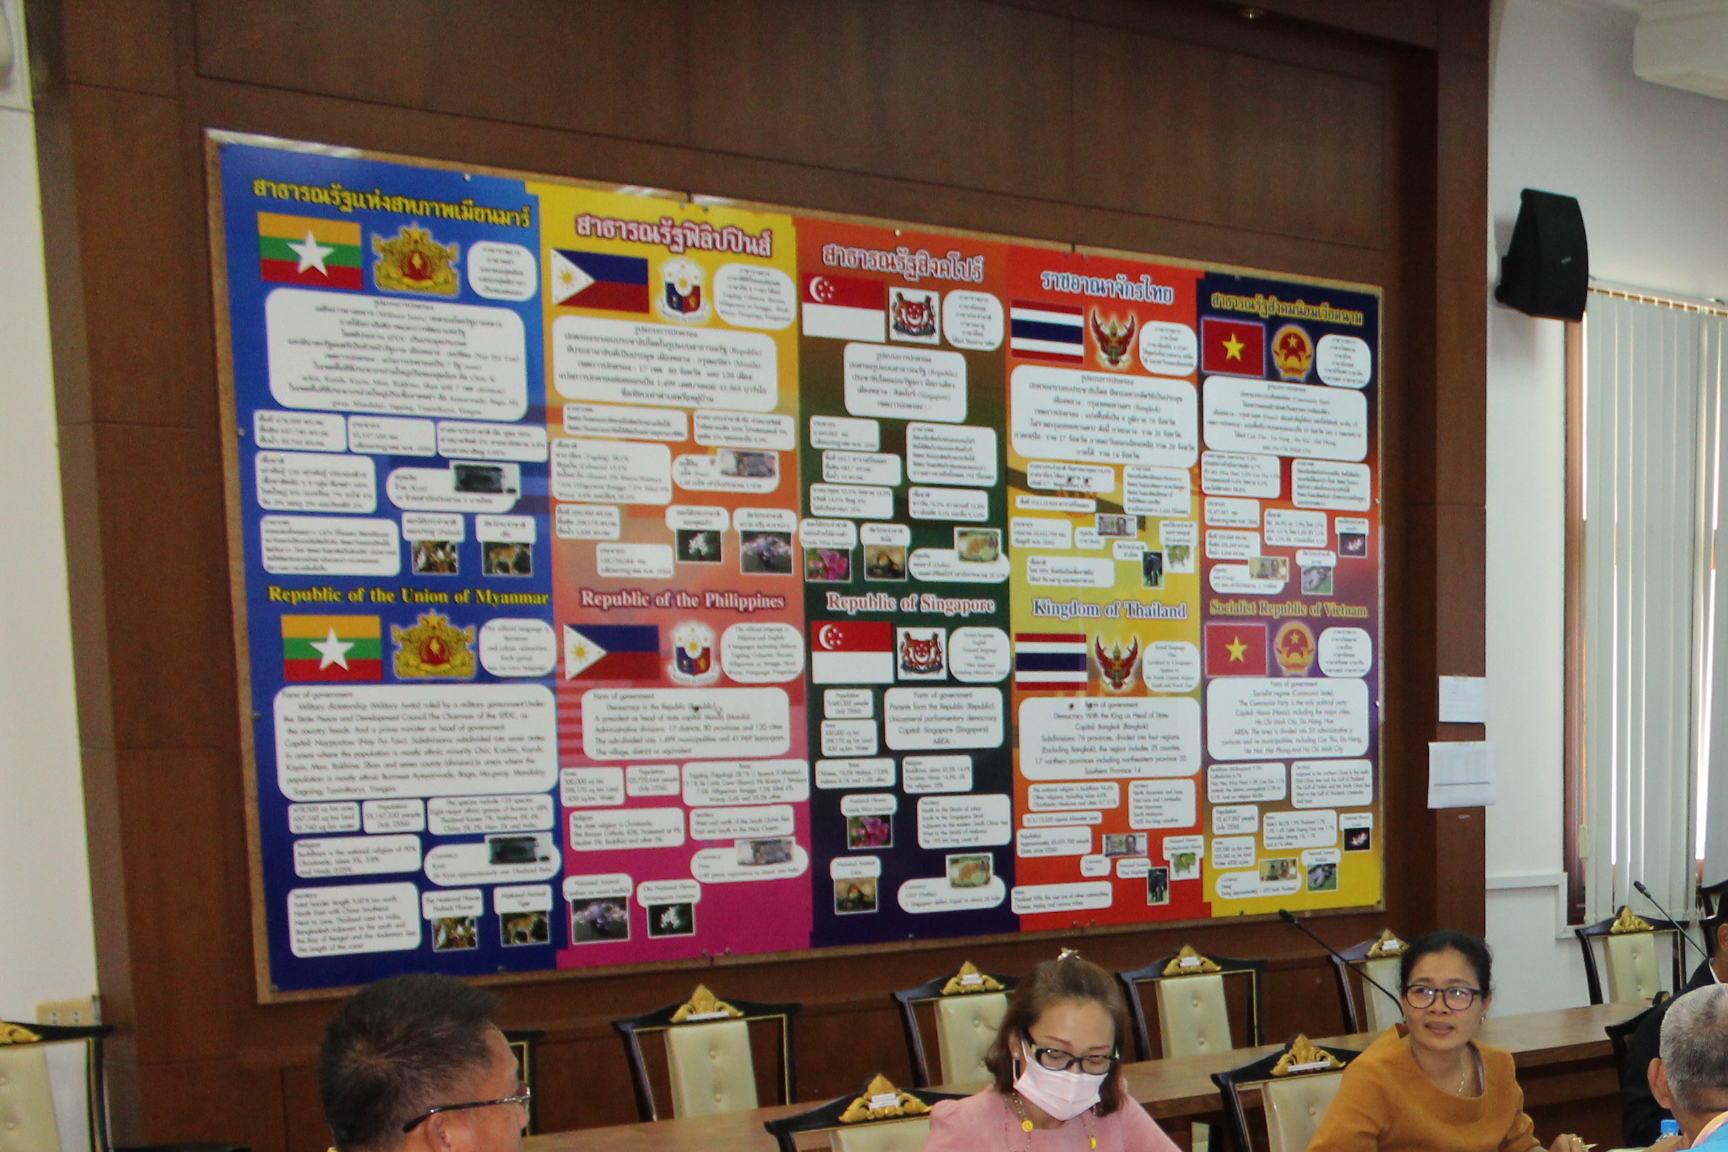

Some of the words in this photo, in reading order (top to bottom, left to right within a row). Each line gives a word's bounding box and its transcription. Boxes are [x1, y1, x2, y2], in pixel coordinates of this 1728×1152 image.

[253, 178, 532, 228] สาธารณรัฐแห่งสหภาพเมียนมาร์
[575, 213, 773, 257] สาธารณรัฐฟิลิปปินส์
[822, 243, 985, 283] สาธารณรัฐสิงคโปร์
[1040, 269, 1175, 305] ราชอาณาจักรไทย
[268, 585, 342, 605] Republic
[348, 587, 365, 603] of
[370, 588, 395, 603] the
[401, 588, 448, 604] Union
[454, 589, 471, 605] of
[475, 589, 549, 607] Myanmar
[580, 588, 650, 610] Republic
[655, 590, 672, 607] of
[675, 591, 700, 608] the
[704, 591, 785, 612] Philippines
[826, 592, 896, 615] Republic
[899, 593, 917, 612] of
[920, 594, 996, 616] Singapore
[1032, 598, 1100, 621] Kingdom
[1104, 601, 1121, 618] of
[1124, 602, 1188, 620] Thailand
[1210, 599, 1256, 616] Socialist
[1259, 601, 1307, 619] Republic
[1309, 602, 1322, 617] of
[1324, 602, 1368, 618] Vietnam
